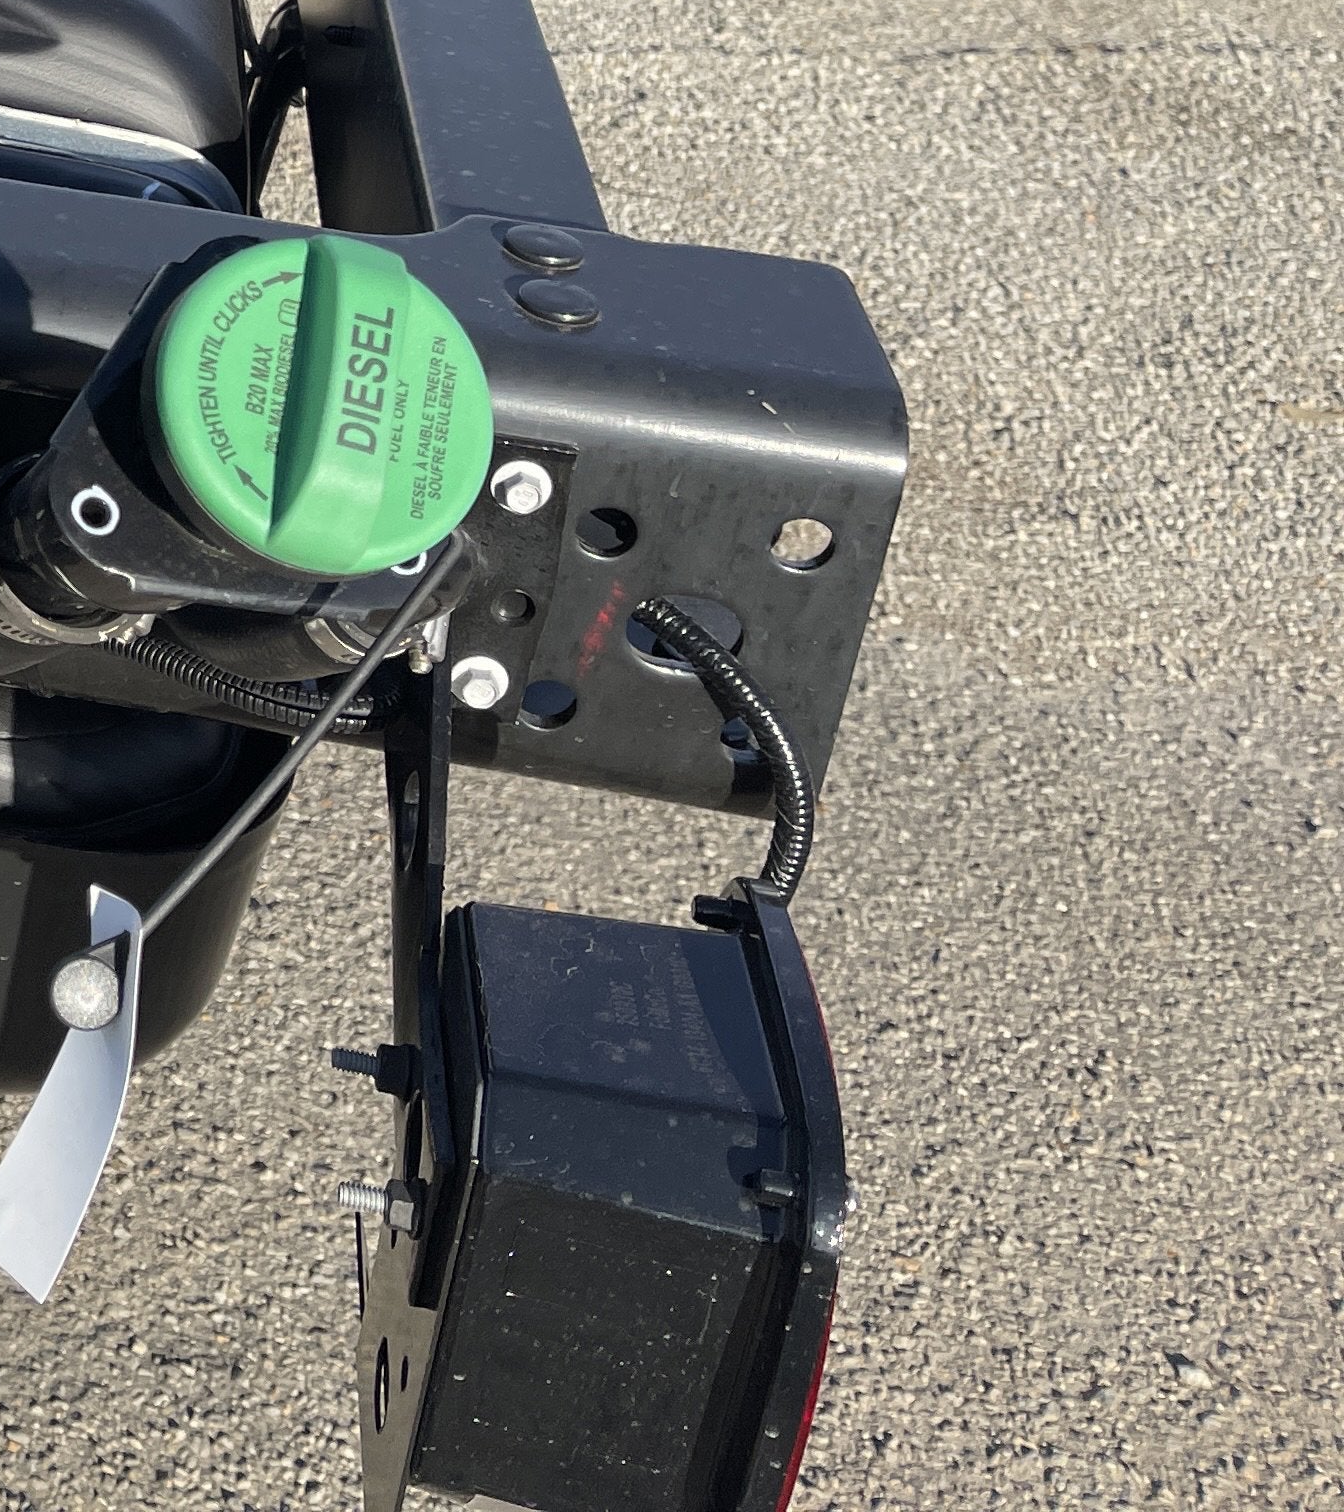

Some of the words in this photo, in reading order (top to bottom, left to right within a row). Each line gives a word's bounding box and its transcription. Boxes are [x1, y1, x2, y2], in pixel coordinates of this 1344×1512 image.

[213, 280, 263, 332] CLICKS
[198, 335, 225, 383] UNTIL
[250, 343, 274, 383] MAX
[272, 334, 296, 396] BIODIESEL
[432, 336, 447, 356] EN
[245, 383, 267, 416] B20
[336, 306, 395, 456] DIESEL
[393, 378, 409, 420] ONLY
[423, 356, 443, 410] TENEUR
[434, 362, 458, 443] SEULEMENT
[198, 386, 237, 465] TIGHTEN
[268, 397, 285, 428] MAX
[417, 411, 435, 457] FAIBLE
[389, 420, 404, 463] FUEL
[413, 459, 428, 472] À
[428, 446, 447, 501] SOUFRE
[410, 475, 428, 520] DIESEL
